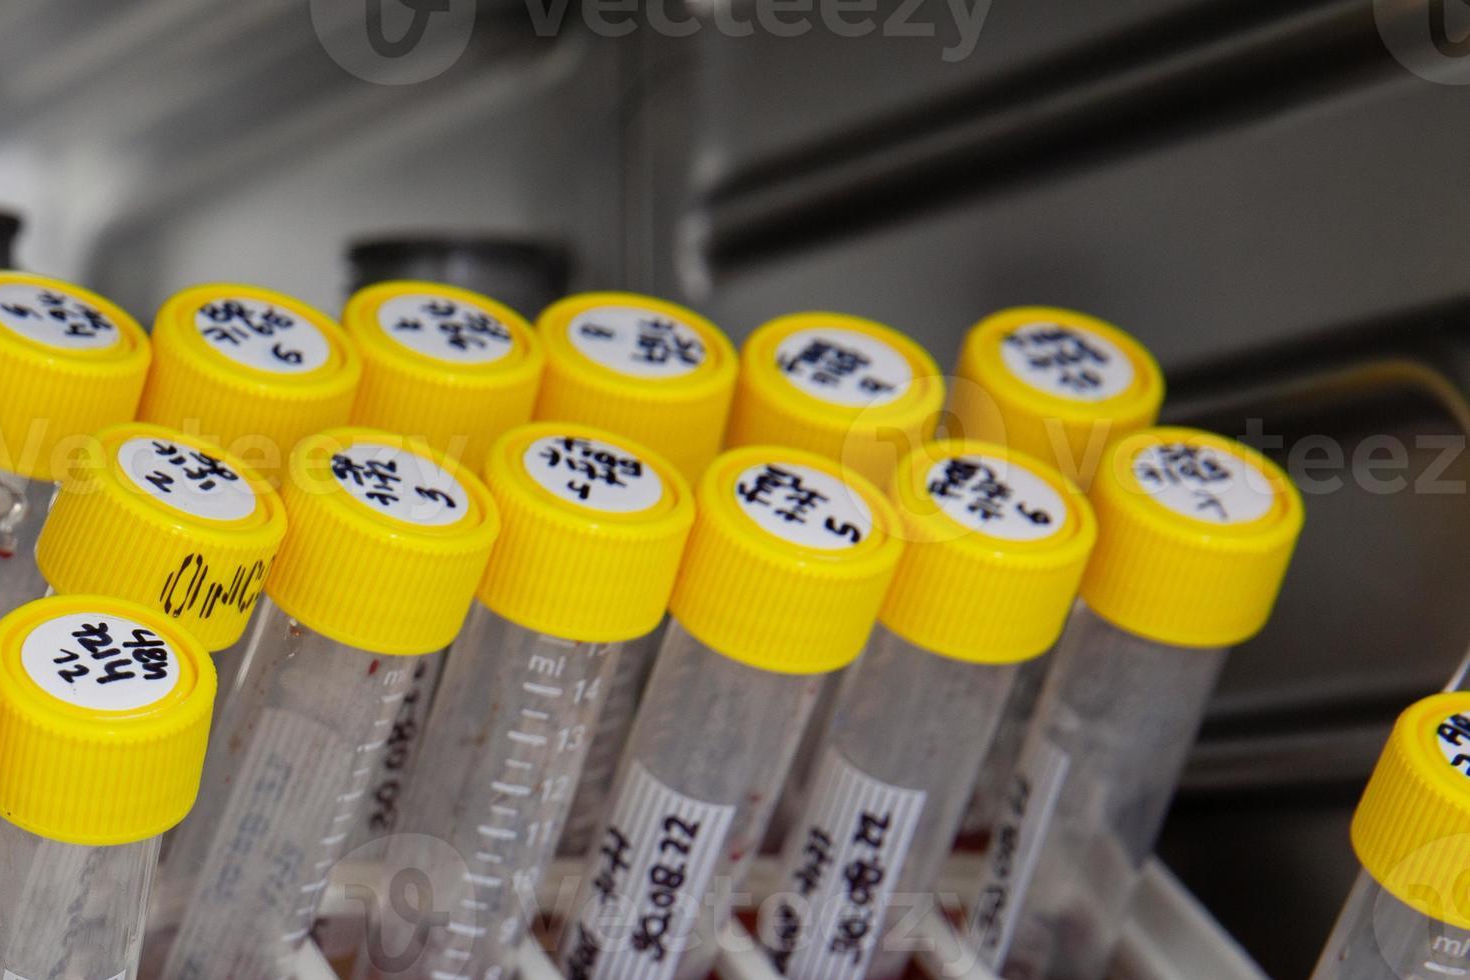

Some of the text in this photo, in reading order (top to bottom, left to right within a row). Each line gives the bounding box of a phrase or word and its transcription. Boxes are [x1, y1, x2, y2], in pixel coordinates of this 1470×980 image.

[272, 344, 303, 364] 6
[146, 471, 174, 493] 2
[568, 479, 591, 499] 4
[1016, 502, 1051, 524] 6
[824, 515, 862, 542] 5
[53, 649, 89, 683] 12
[528, 654, 565, 678] ml
[573, 676, 601, 704] 14
[557, 725, 586, 751] 13
[540, 775, 570, 801] 12
